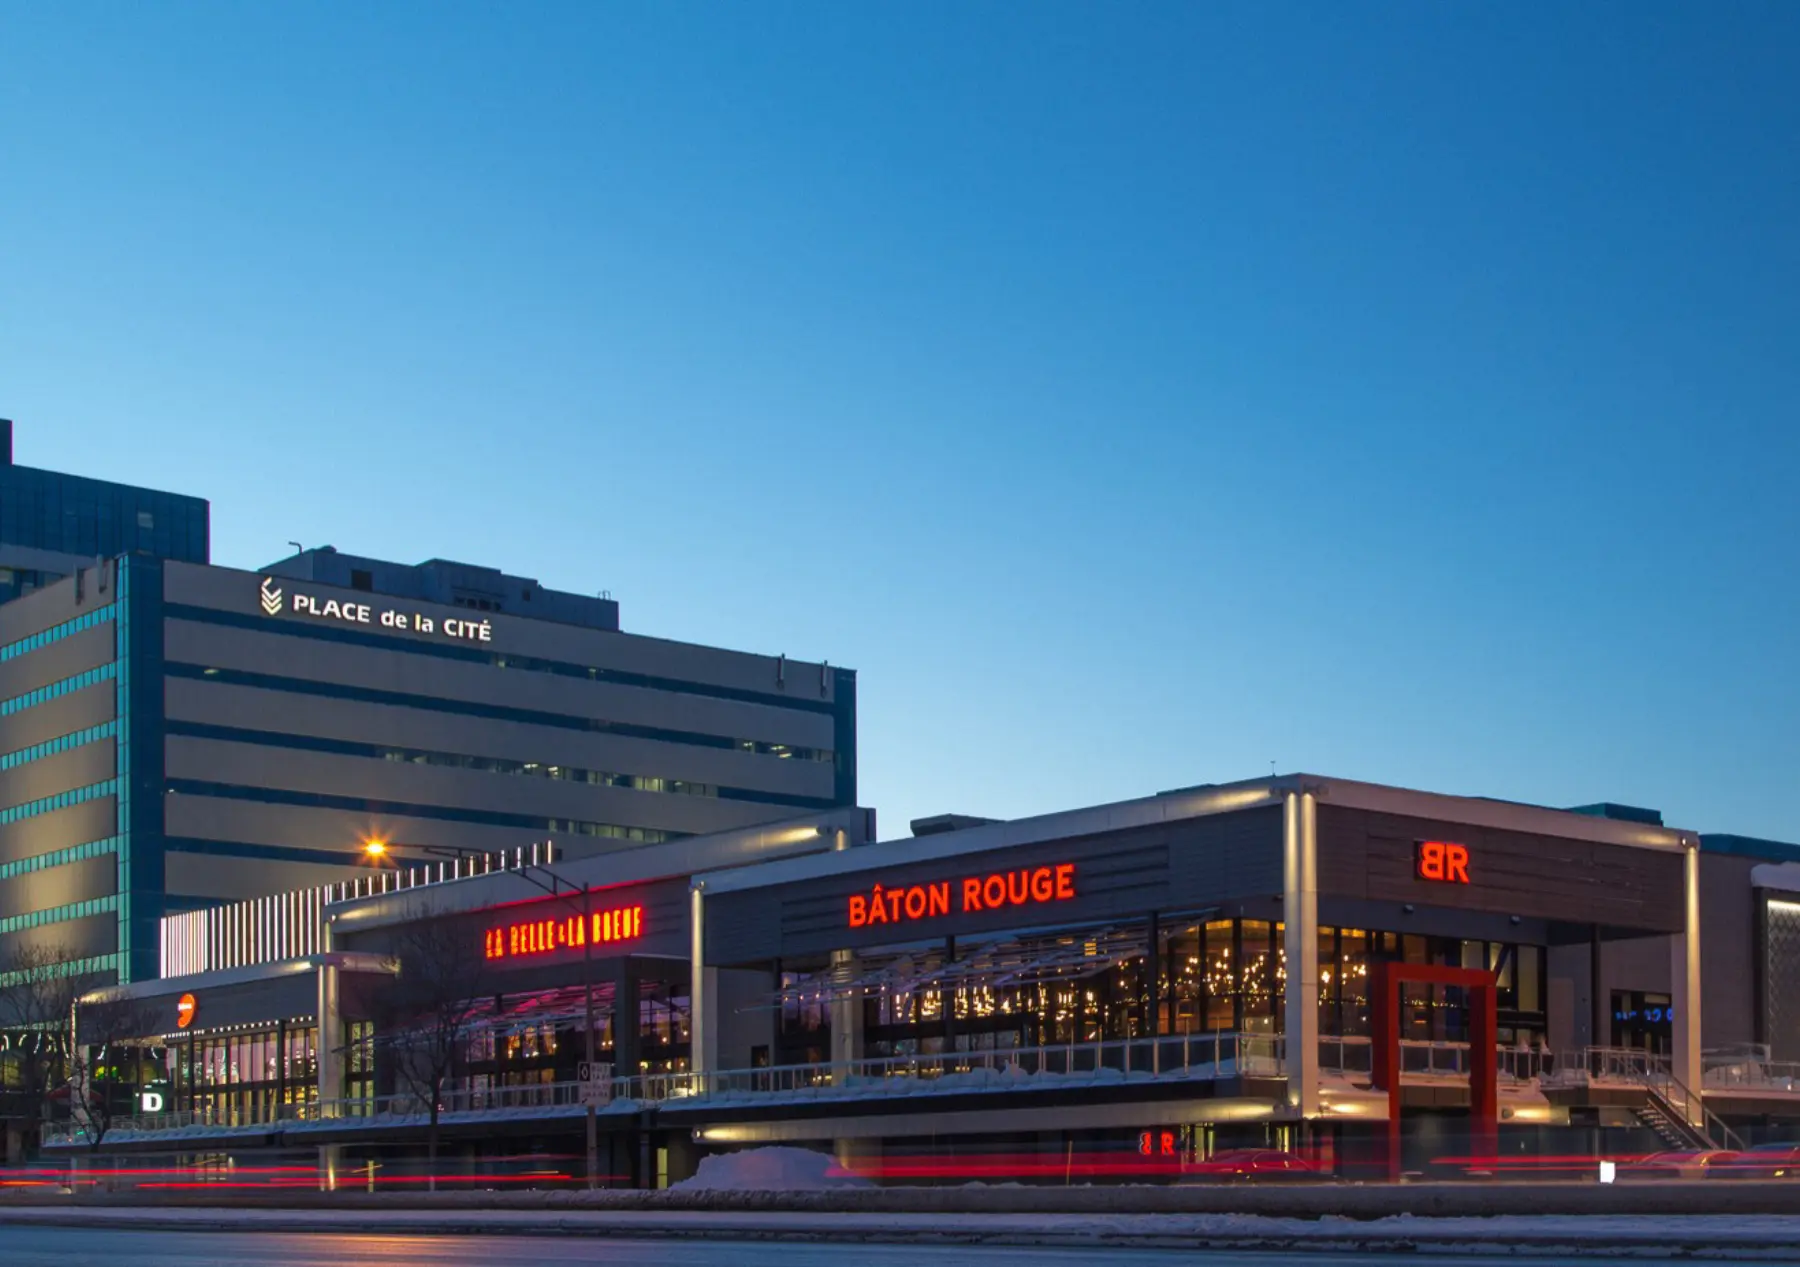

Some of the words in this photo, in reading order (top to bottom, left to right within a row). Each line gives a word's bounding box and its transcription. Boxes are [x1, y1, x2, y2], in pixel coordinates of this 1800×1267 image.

[293, 594, 371, 623] PLACE
[380, 609, 408, 629] de
[415, 613, 434, 633] la
[443, 619, 492, 641] CITÉ
[849, 882, 949, 928] BÂTON
[963, 863, 1075, 912] ROUGE
[486, 928, 503, 958] LA
[510, 920, 555, 955] BELLE
[567, 915, 585, 947] LA
[142, 1092, 163, 1112] D
